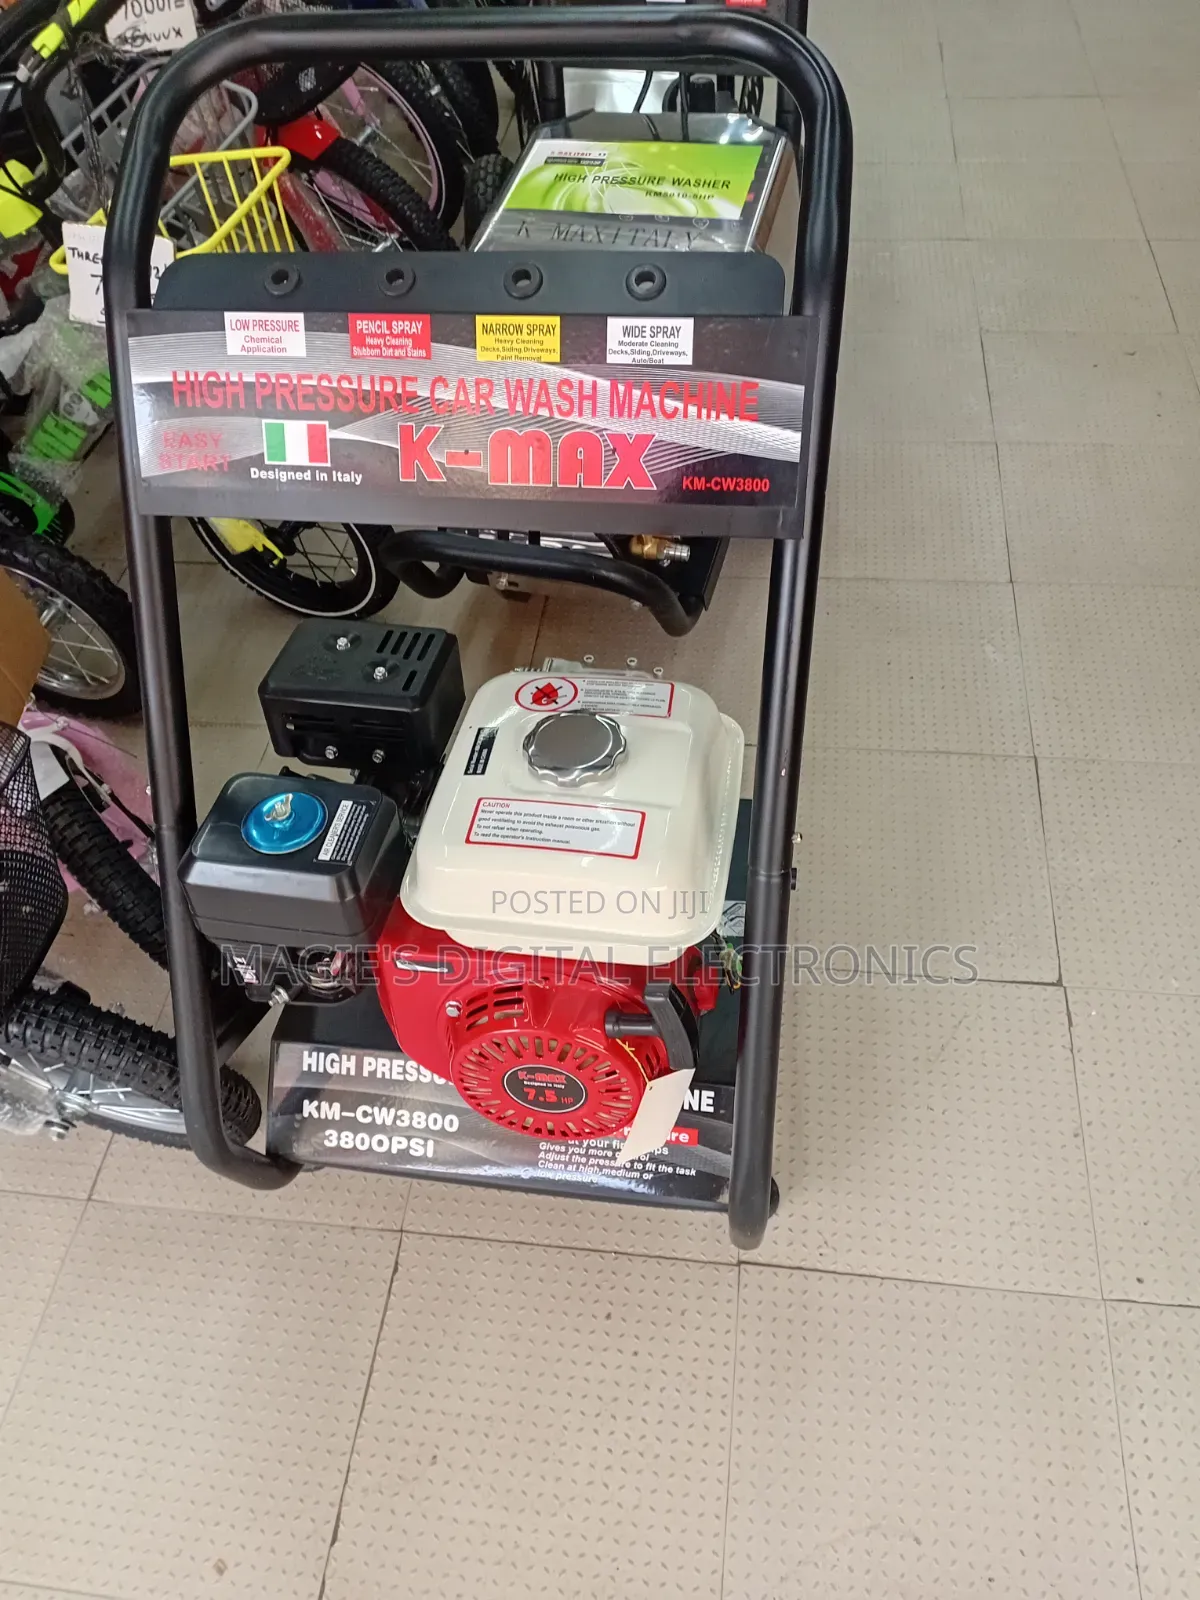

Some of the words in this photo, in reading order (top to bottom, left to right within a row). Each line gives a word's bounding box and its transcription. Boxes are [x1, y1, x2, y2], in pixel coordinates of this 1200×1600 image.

[554, 172, 588, 184] HIGH
[592, 175, 665, 187] PRESSURE
[671, 177, 731, 190] WASHER
[67, 246, 103, 264] THRE
[230, 319, 250, 331] LOW
[252, 319, 300, 332] PRESSURE
[356, 320, 390, 333] PENCIL
[391, 320, 423, 334] SPRAY
[481, 323, 524, 336] NARROW
[526, 324, 557, 337] SPRAY
[622, 325, 647, 338] WIDE
[649, 326, 682, 339] SPRAY
[244, 335, 283, 344] Chemical
[365, 336, 384, 346] Heavy
[385, 337, 412, 347] Cleaning
[494, 338, 514, 346] Heavy
[515, 338, 544, 347] Cleaning
[617, 340, 648, 348] Moderate
[649, 340, 679, 349] Cleaning
[240, 345, 287, 354] Application
[353, 346, 381, 356] Stubborn
[382, 347, 394, 357] Dirt
[394, 348, 406, 357] and
[406, 348, 426, 357] Stains
[496, 354, 513, 362] Paint
[514, 354, 542, 362] Removal
[631, 357, 665, 365] Auto/Boat
[172, 370, 245, 409] HIGH
[255, 372, 420, 413] PRESSURE
[430, 375, 495, 416] CAR
[504, 378, 598, 417] WASH
[609, 379, 760, 422] MACHINE
[162, 430, 223, 449] EASY
[158, 452, 230, 471] START
[397, 421, 658, 491] K-MAX
[250, 467, 312, 482] Designed
[315, 470, 329, 482] in
[332, 470, 363, 485] Italy
[682, 476, 770, 493] KM-CW3800
[302, 1050, 356, 1076] HIGH
[362, 1056, 454, 1086] PRESS
[524, 1088, 558, 1103] 7.5
[302, 1099, 459, 1133] KM-CW3800
[323, 1129, 434, 1158] 3800PSI
[539, 1141, 566, 1152] Gives
[568, 1146, 586, 1155] you
[588, 1149, 613, 1158] more
[582, 1138, 610, 1148] your
[538, 1151, 570, 1162] Adjust
[572, 1154, 587, 1164] the
[634, 1161, 643, 1170] to
[645, 1162, 656, 1172] fit
[658, 1164, 674, 1174] the
[675, 1166, 697, 1177] task
[538, 1160, 565, 1170] Clean
[566, 1163, 577, 1172] at
[642, 1171, 654, 1180] or
[537, 1169, 553, 1178] low
[555, 1172, 598, 1184] pressure
